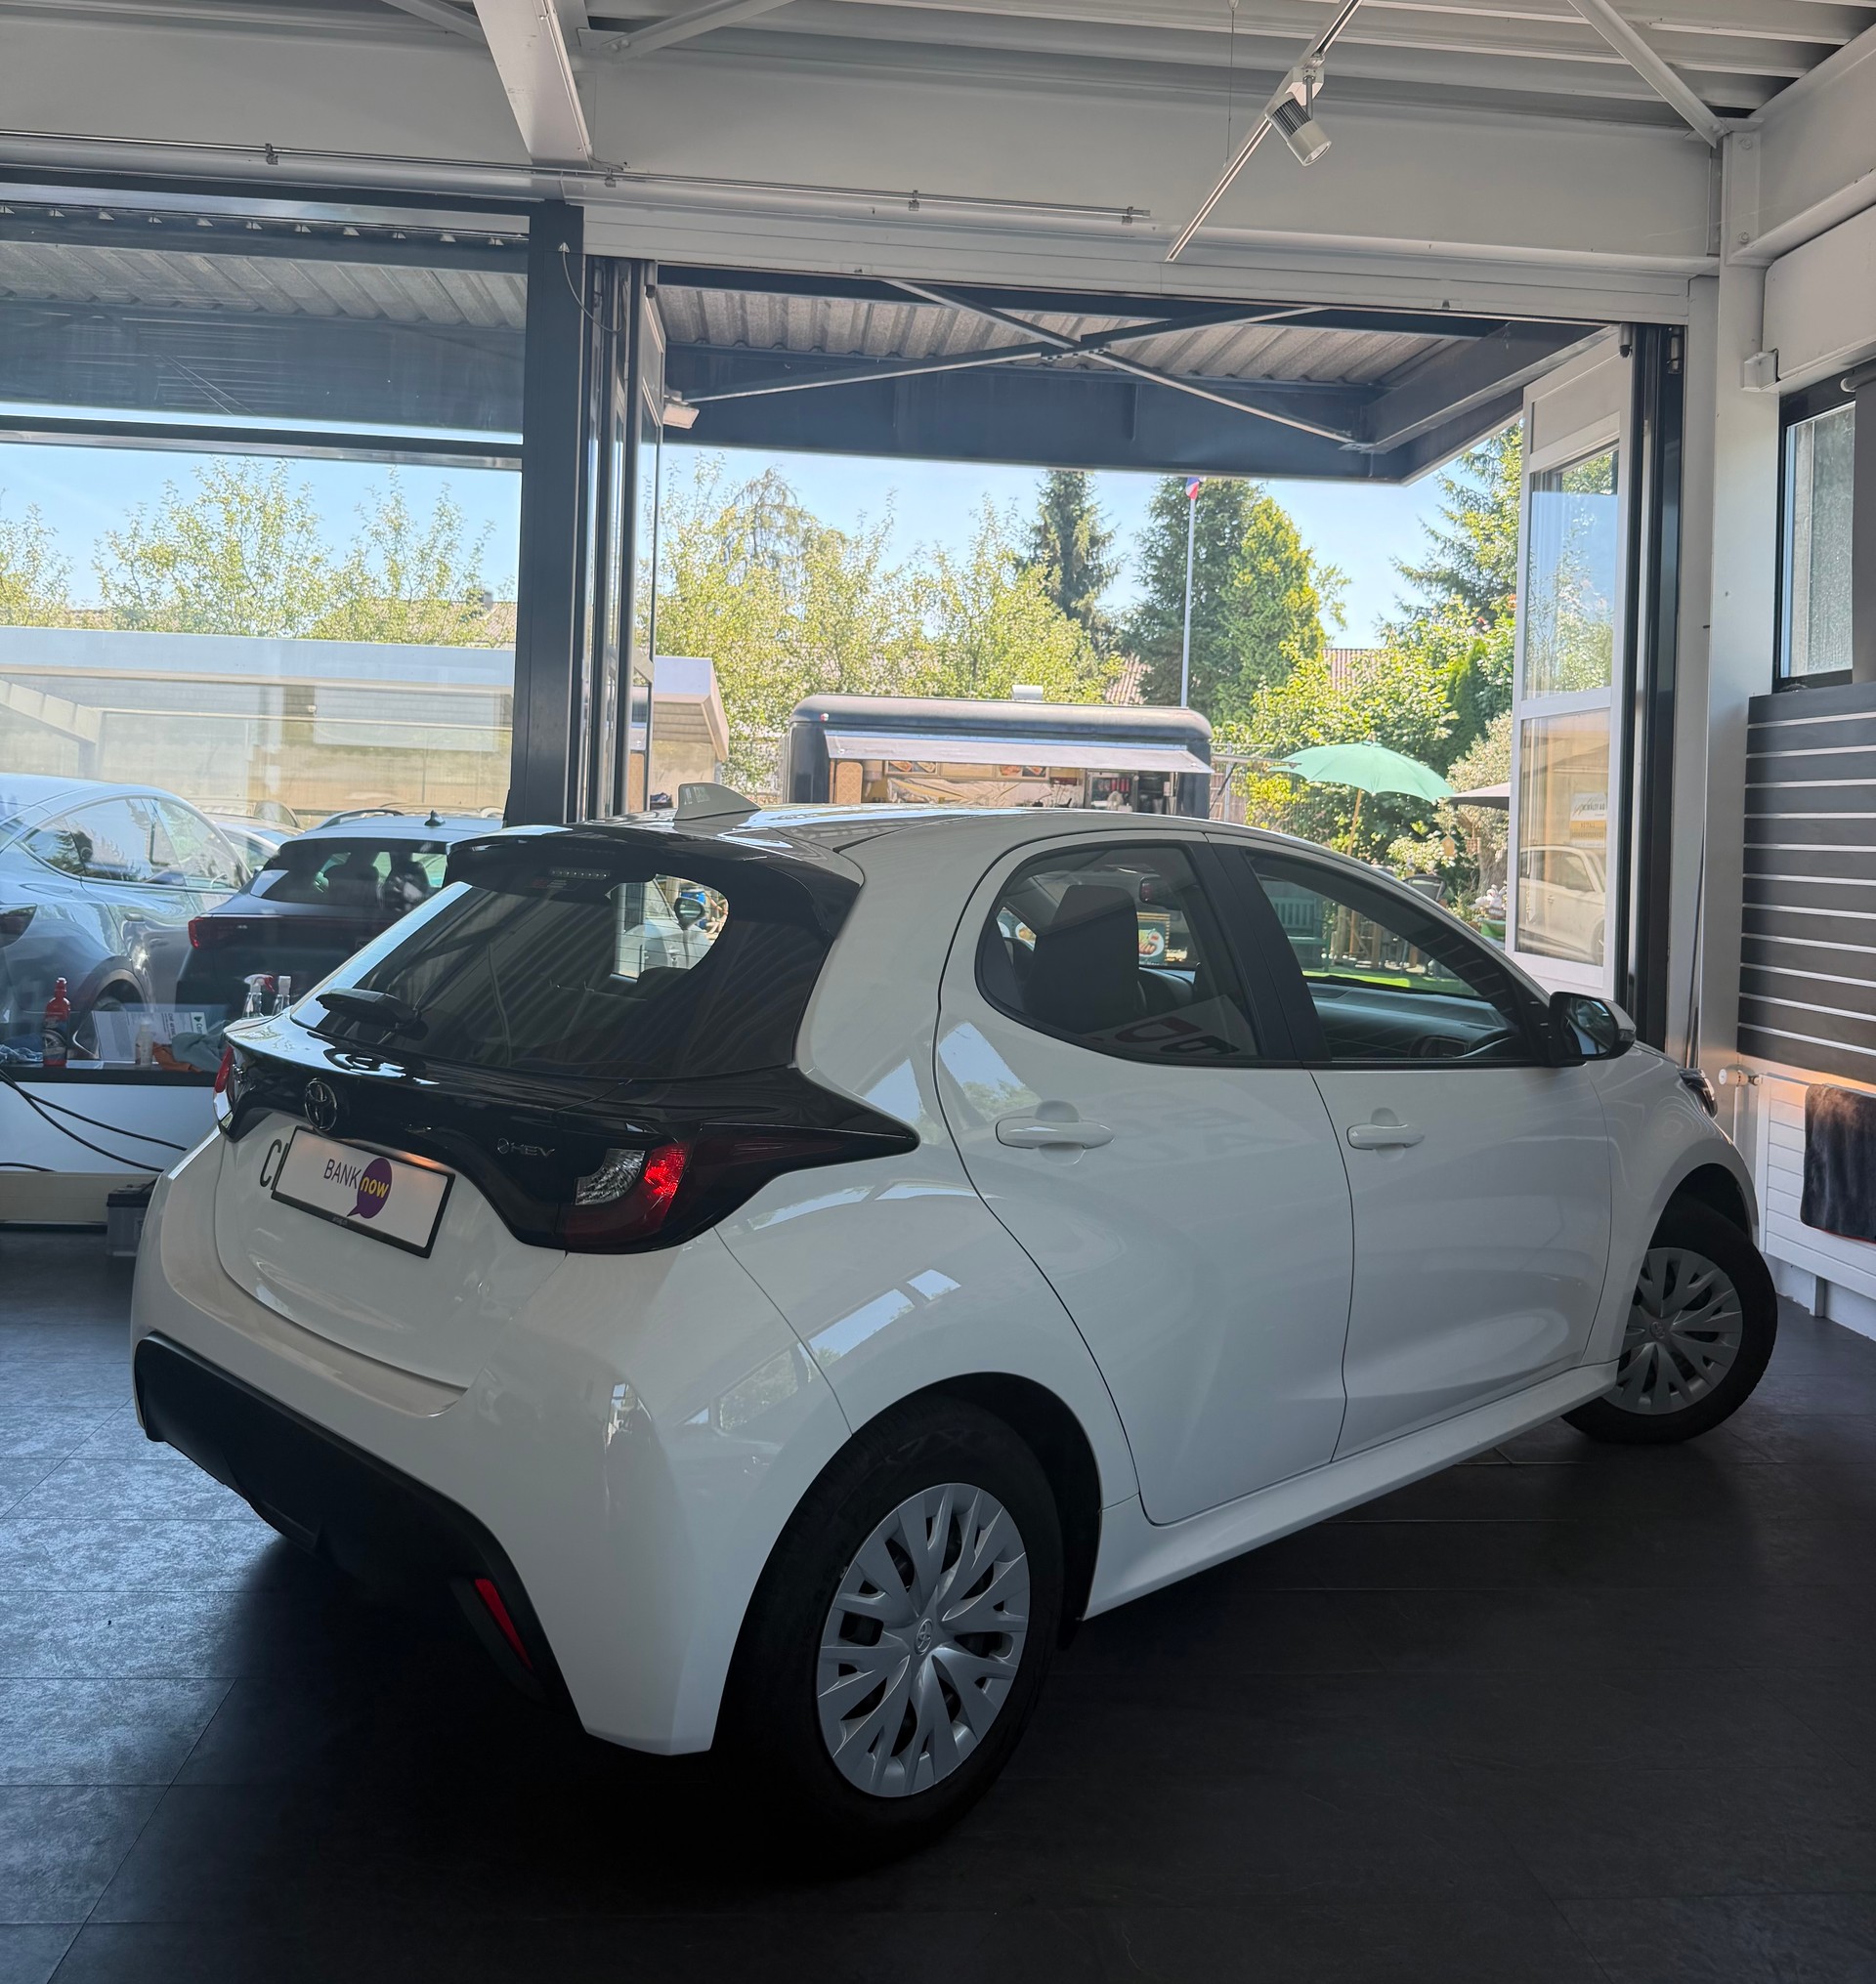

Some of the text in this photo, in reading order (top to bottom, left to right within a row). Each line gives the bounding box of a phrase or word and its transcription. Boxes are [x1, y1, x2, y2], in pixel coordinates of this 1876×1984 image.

[510, 1142, 556, 1159] HEV
[323, 1159, 389, 1199] BANK now
